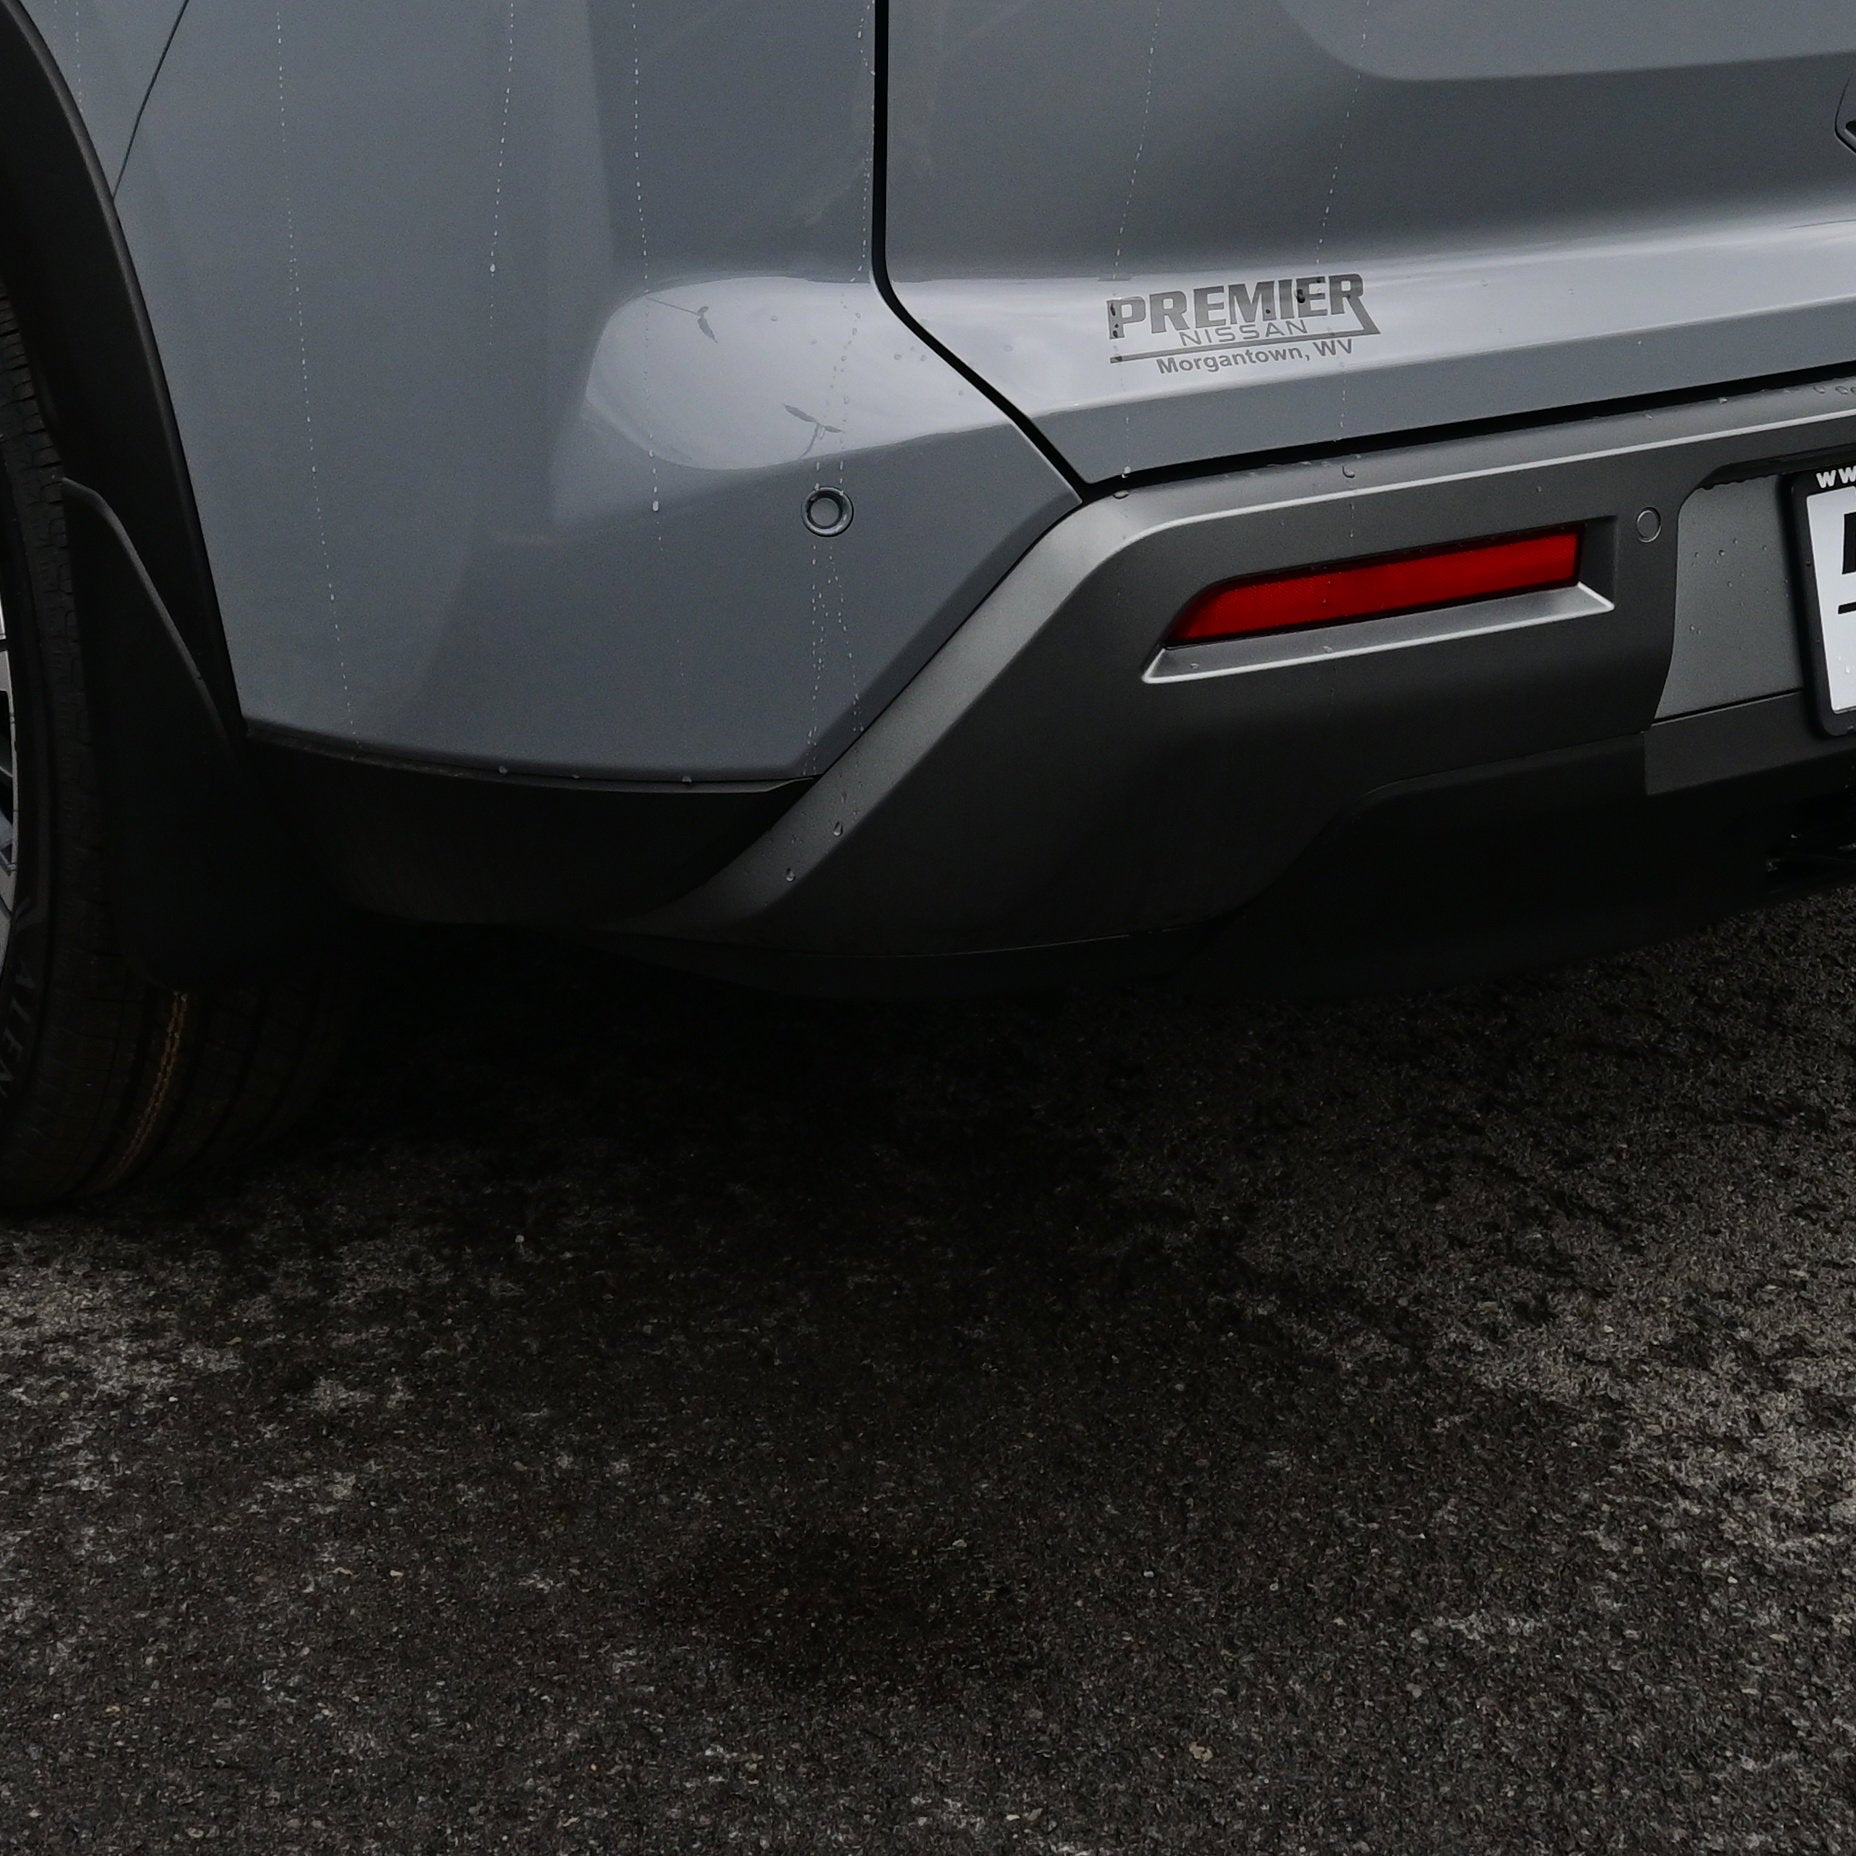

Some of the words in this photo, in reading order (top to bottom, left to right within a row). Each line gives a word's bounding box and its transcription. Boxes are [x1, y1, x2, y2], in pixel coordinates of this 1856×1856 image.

[1106, 273, 1381, 340] PREMIER
[1181, 319, 1307, 346] NISSAN
[1156, 344, 1310, 374] Morgantown,
[1313, 338, 1353, 358] WV
